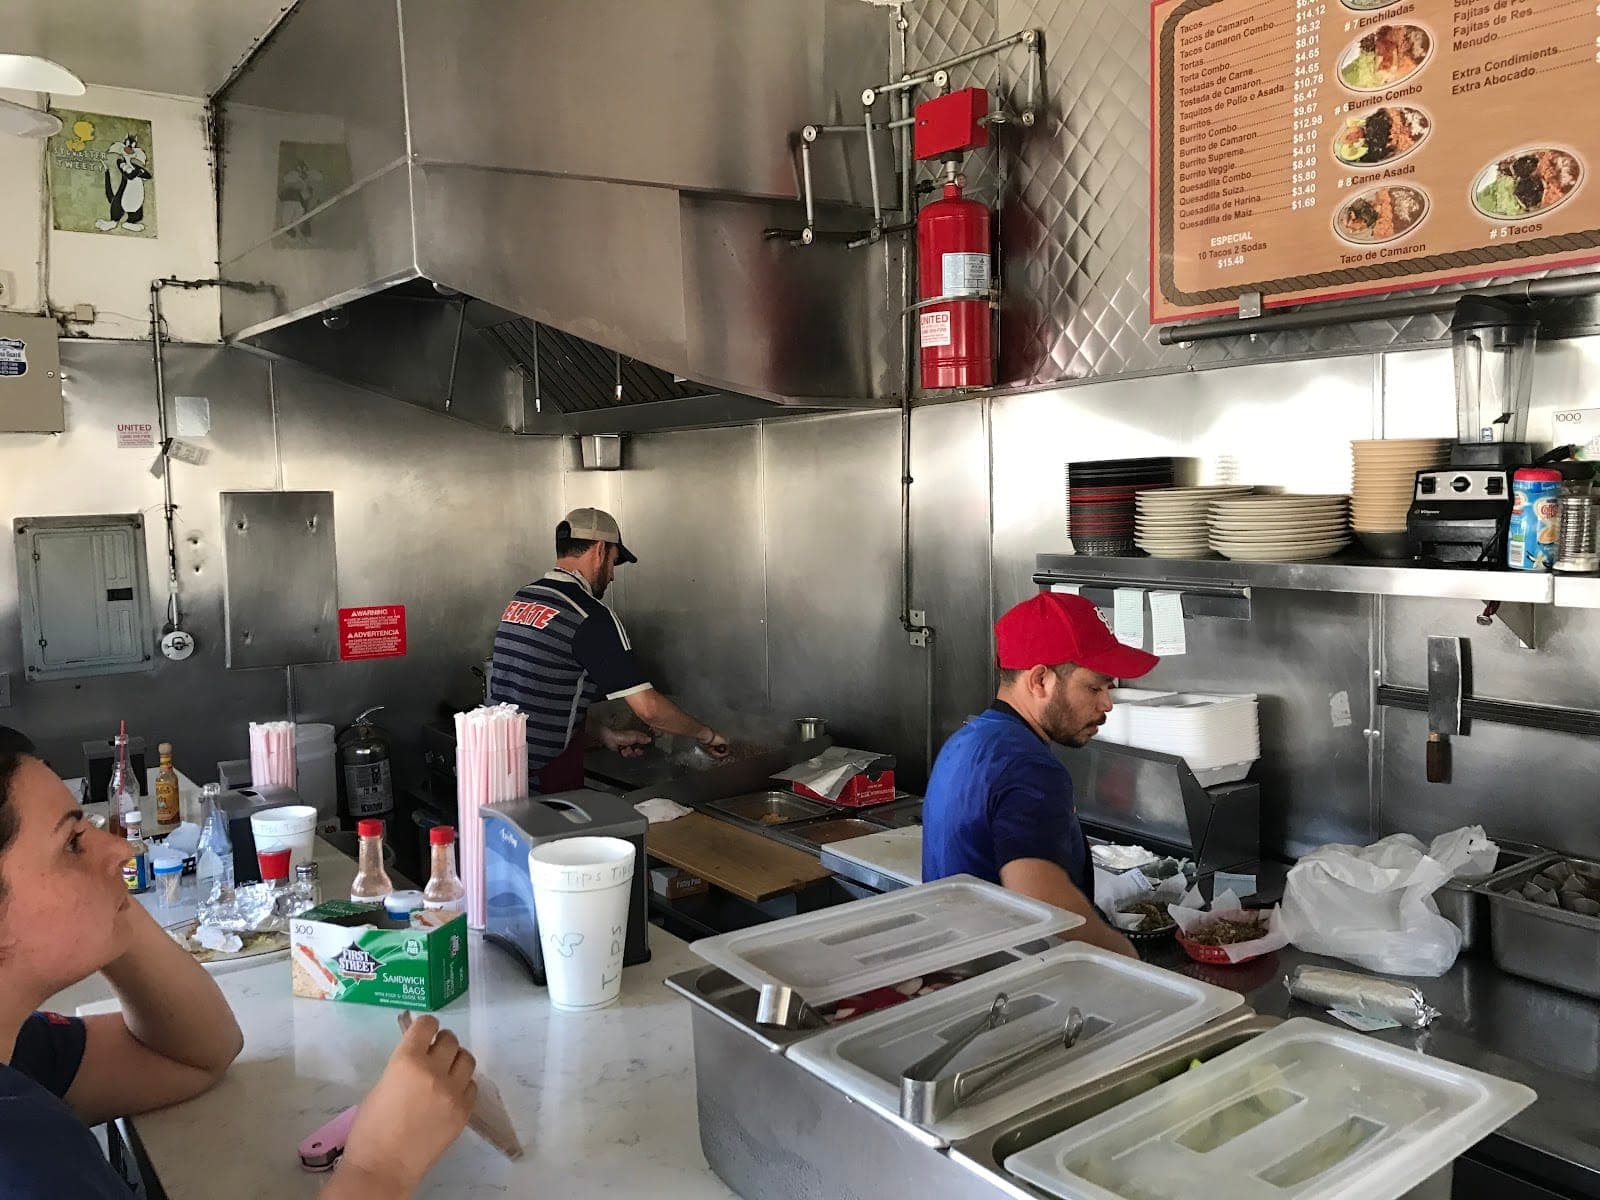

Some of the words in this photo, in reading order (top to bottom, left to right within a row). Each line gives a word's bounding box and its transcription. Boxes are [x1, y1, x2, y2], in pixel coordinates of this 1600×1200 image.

[1359, 4, 1415, 28] Enchiladas
[1453, 20, 1490, 37] Fajitas
[1493, 15, 1507, 26] de
[1511, 7, 1533, 20] Res
[1454, 5, 1490, 23] Fajitas
[1494, 0, 1507, 10] de
[1180, 20, 1203, 34] Tacos
[1180, 35, 1203, 47] Tacos
[1204, 28, 1214, 38] de
[1216, 15, 1254, 33] Camaron
[1180, 47, 1202, 59] Tacos
[1204, 33, 1241, 50] Camaron
[1243, 21, 1274, 38] Combo
[1296, 4, 1326, 22] $14.12
[1180, 59, 1204, 72] Tortas
[1296, 20, 1321, 36] $6.32
[1453, 32, 1498, 52] Menudo
[1180, 72, 1199, 84] Torta
[1201, 62, 1230, 77] Combo
[1295, 34, 1319, 50] $8.01
[1452, 66, 1481, 80] Extra
[1484, 45, 1558, 72] Condimients
[1180, 79, 1214, 97] Tostadas
[1217, 74, 1227, 84] de
[1228, 67, 1253, 81] Carne
[1295, 48, 1320, 63] $4.65
[1452, 81, 1481, 95] Extra
[1484, 67, 1536, 87] Abocado
[1180, 93, 1210, 109] Tostada
[1212, 88, 1222, 98] de
[1224, 78, 1262, 95] Camaron
[1295, 62, 1320, 77] $4.65
[1180, 105, 1212, 121] Taquitos
[1215, 101, 1224, 112] de
[1226, 96, 1248, 107] Pollo
[1250, 92, 1255, 101] o
[1257, 84, 1285, 98] Asada
[1294, 73, 1324, 91] $10.78
[1348, 95, 1382, 111] Burrito
[1385, 85, 1423, 101] Combo
[1179, 119, 1211, 133] Burritos
[1294, 88, 1317, 104] $6.47
[1179, 133, 1206, 146] Burrito
[1208, 124, 1237, 138] Combo
[1293, 103, 1318, 117] $9.67
[1179, 145, 1206, 158] Burrito
[1208, 140, 1218, 150] de
[1220, 131, 1257, 147] Camaron
[1293, 115, 1322, 130] $12.98
[58, 160, 105, 172] TWEETY
[1179, 157, 1206, 170] Burrito
[1208, 147, 1244, 163] Supreme
[1179, 170, 1206, 182] Burrito
[1208, 162, 1235, 175] Veggie
[1293, 144, 1316, 158] $4.61
[1180, 178, 1220, 194] Quesadilla
[1222, 171, 1251, 184] Combo
[1352, 172, 1380, 185] Carne
[1383, 164, 1415, 178] Asada
[1180, 191, 1220, 206] Quesadilla
[1222, 185, 1245, 198] Suiza
[1180, 204, 1220, 218] Quesadilla
[1222, 198, 1232, 209] de
[1234, 194, 1261, 207] Harina
[1292, 184, 1316, 197] $3.40
[1180, 216, 1220, 230] Quesadilla
[1222, 211, 1232, 222] de
[1292, 197, 1316, 211] $1.69
[1210, 231, 1253, 247] ESPECIAL
[1508, 222, 1543, 235] Tacos
[1198, 251, 1207, 261] 10
[1209, 248, 1232, 259] Tacos
[1234, 246, 1239, 254] 2
[1241, 242, 1267, 253] Sodas
[1218, 255, 1244, 269] $15.48
[1340, 254, 1362, 265] Taco
[1365, 251, 1377, 260] de
[1380, 243, 1426, 258] Camaron
[117, 424, 152, 432] UNITED
[1555, 413, 1582, 422] 1000
[357, 609, 388, 617] WARNING
[354, 629, 399, 638] ADVERTENCIA
[295, 924, 313, 935] 300
[339, 960, 376, 973] STREET
[342, 949, 370, 962] FIRST
